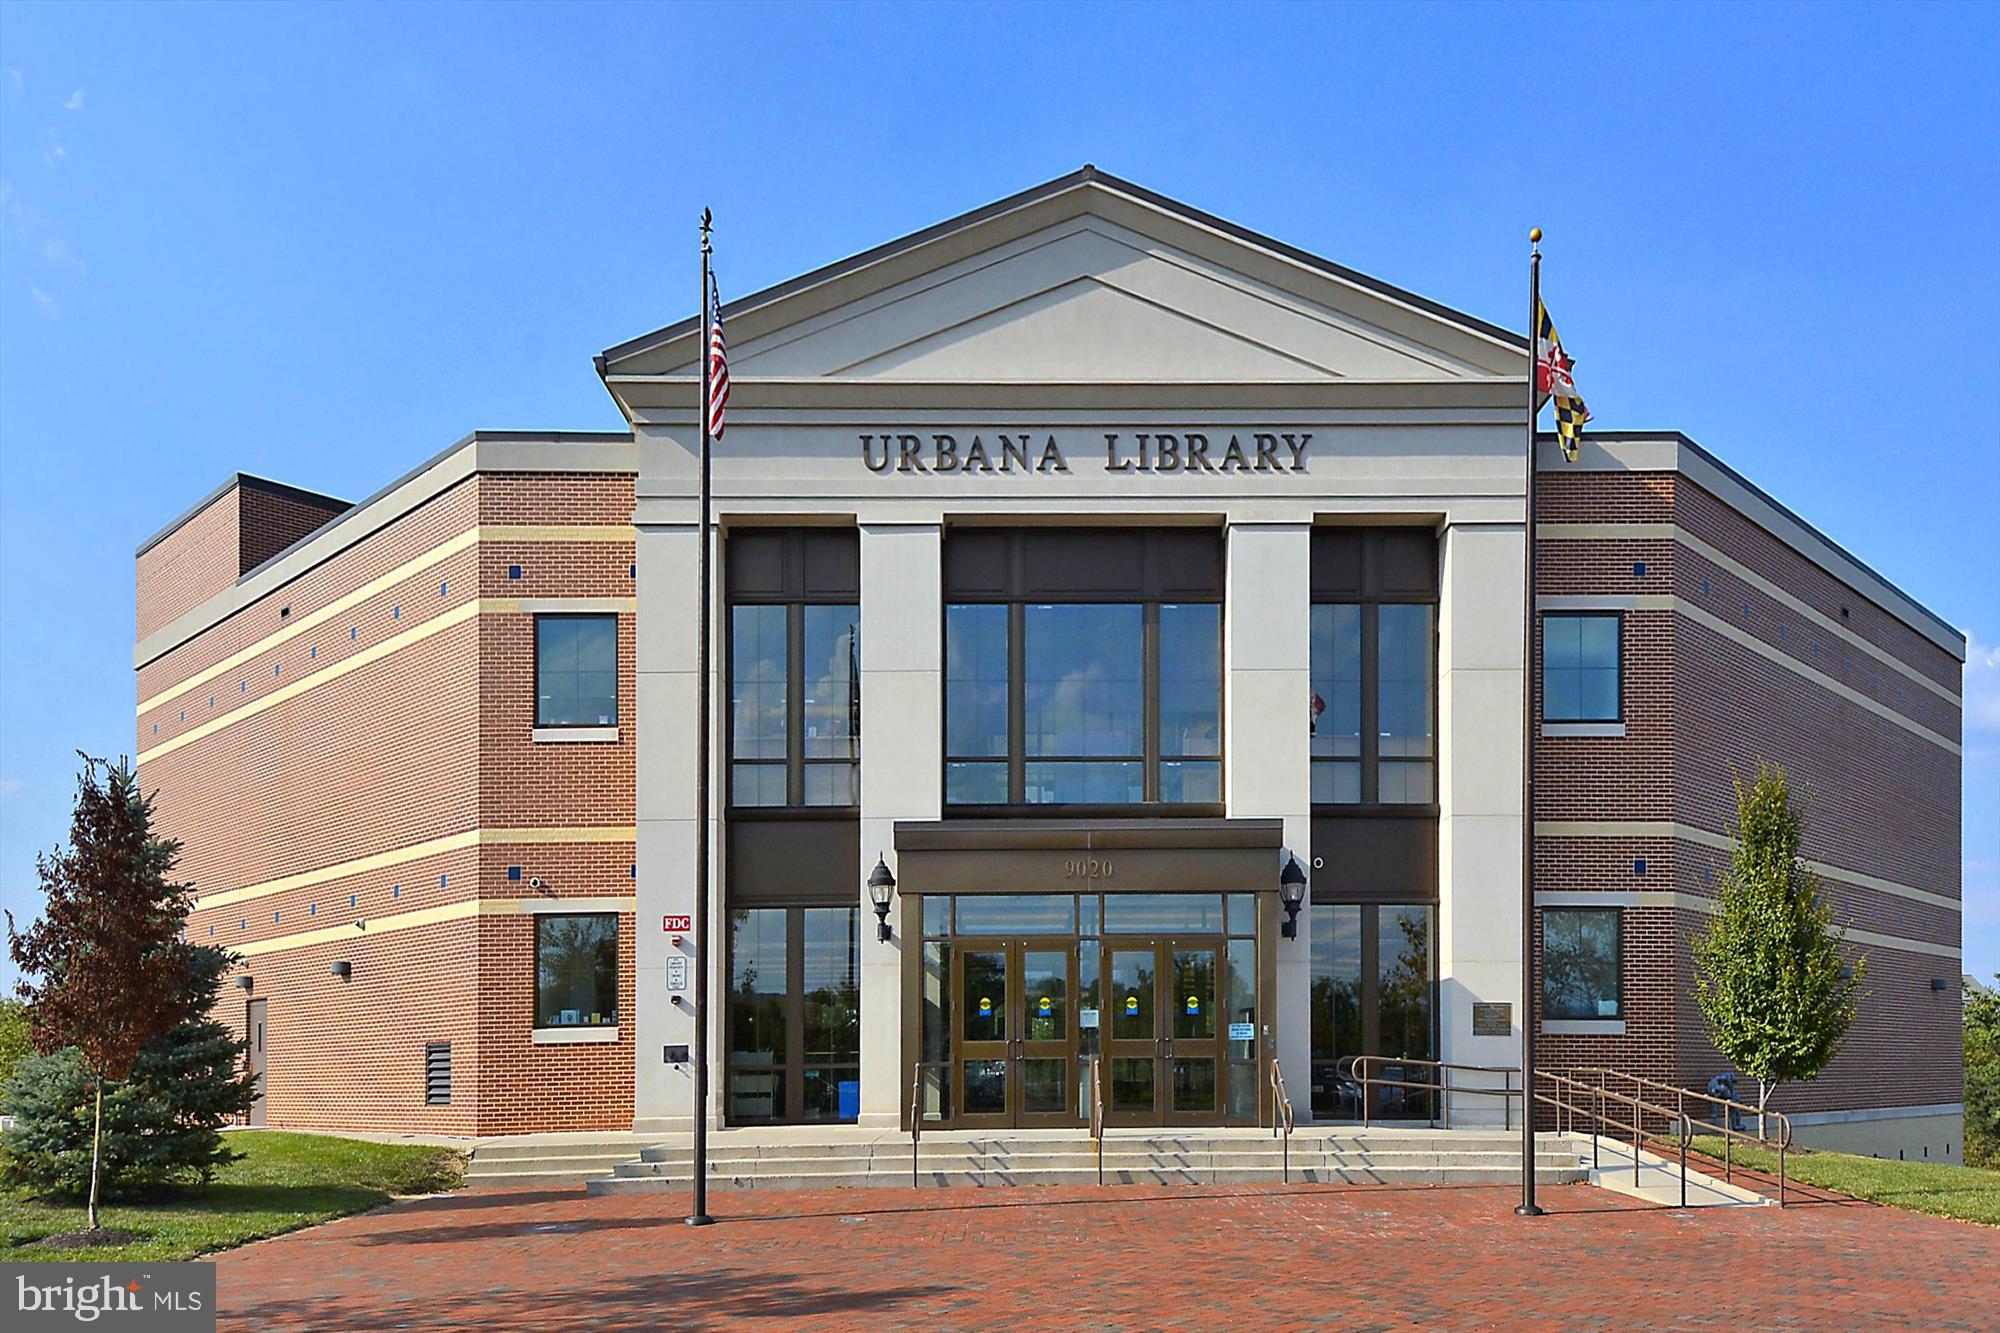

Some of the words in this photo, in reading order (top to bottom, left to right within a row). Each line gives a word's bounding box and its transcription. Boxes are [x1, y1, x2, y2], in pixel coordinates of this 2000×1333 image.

[858, 434, 1069, 472] URBANA
[1104, 433, 1313, 472] LIBRARY
[1064, 859, 1114, 879] 9020
[664, 917, 690, 930] FDC
